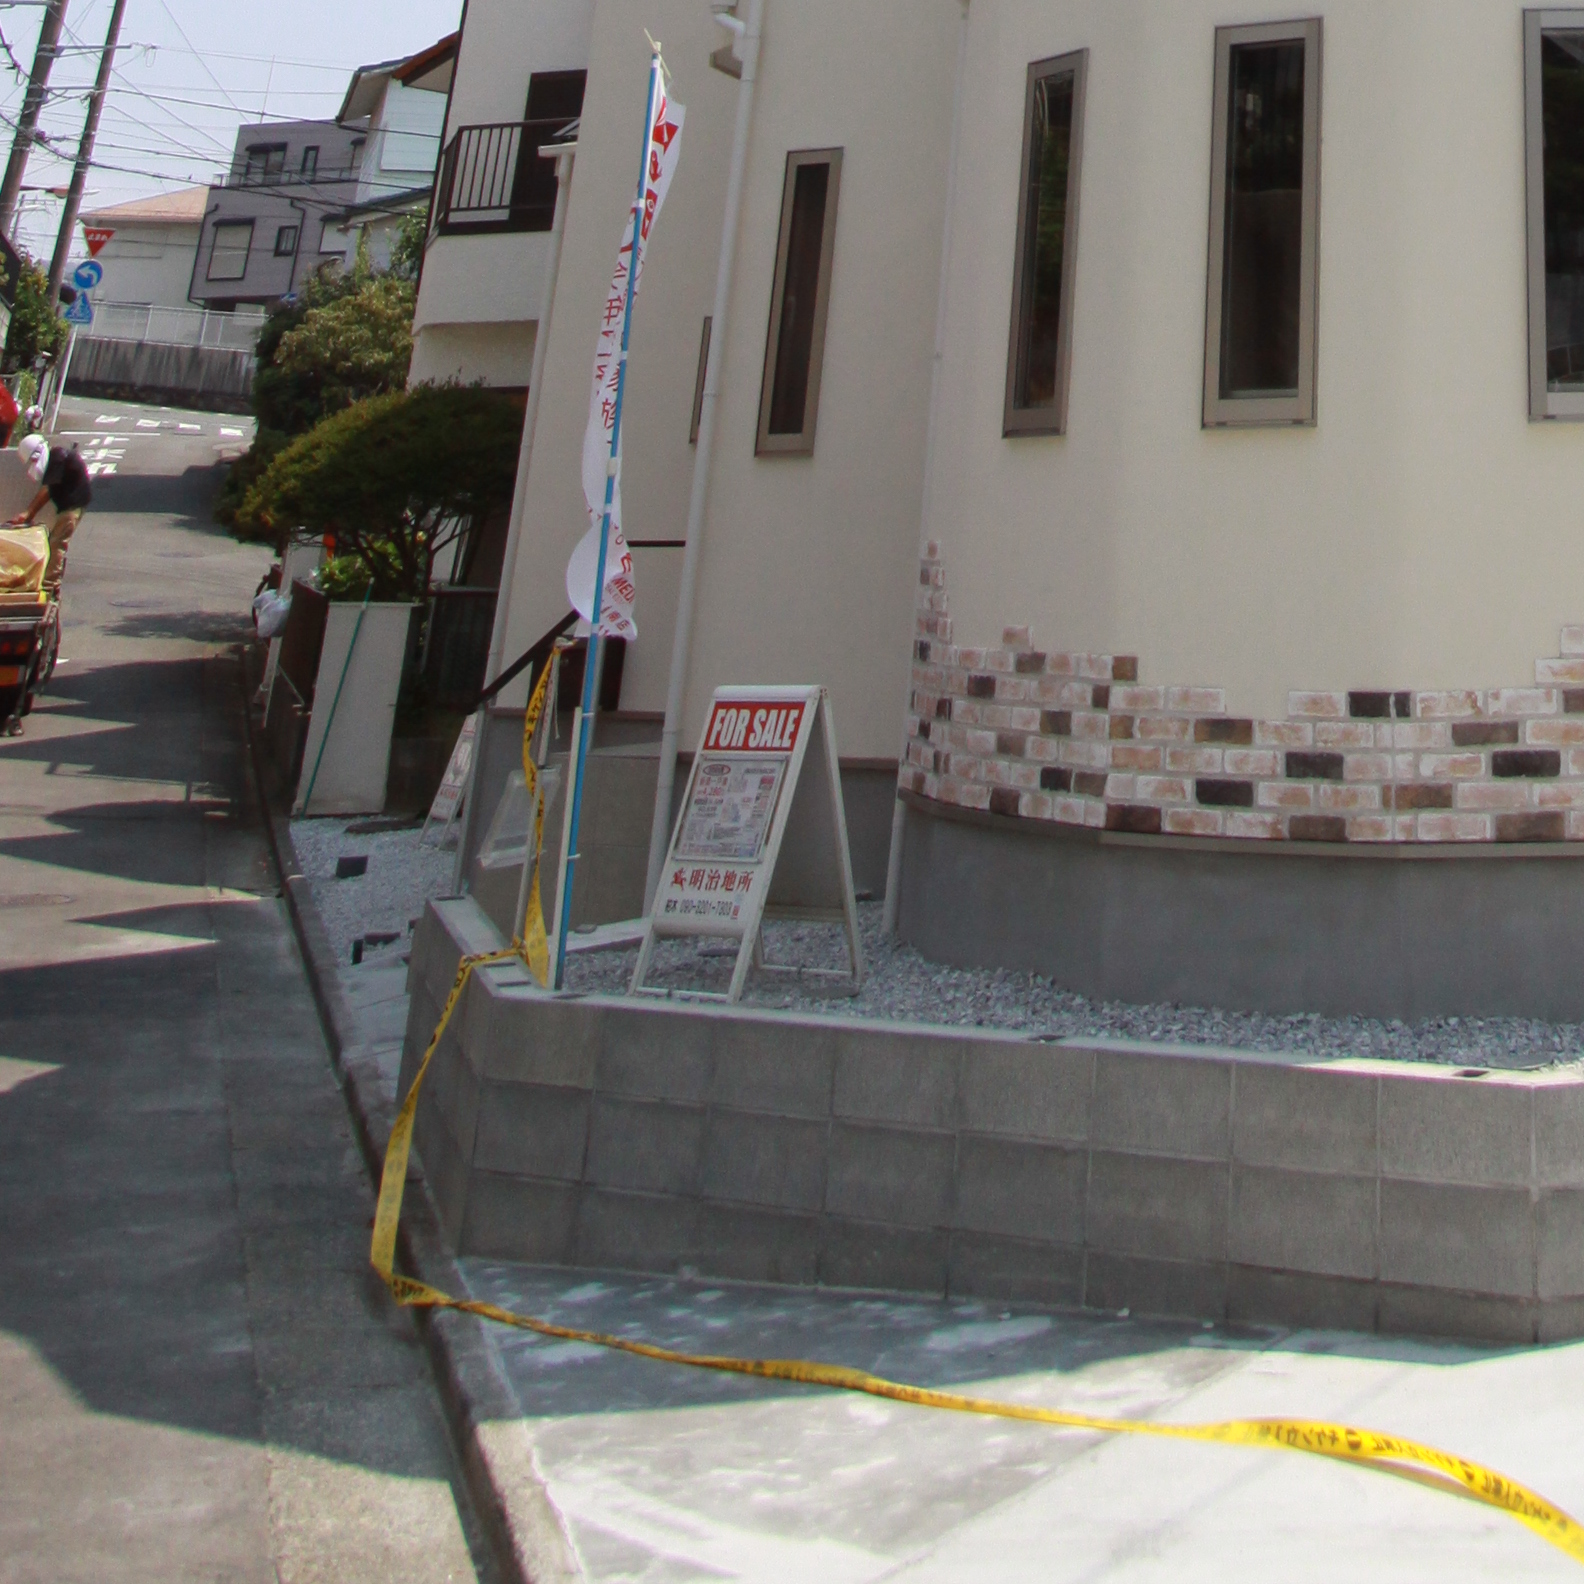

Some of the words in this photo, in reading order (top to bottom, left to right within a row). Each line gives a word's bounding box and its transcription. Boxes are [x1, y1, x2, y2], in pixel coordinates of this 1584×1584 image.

[708, 708, 751, 747] FOR
[748, 708, 799, 748] SALE
[689, 868, 754, 892] 明治地所
